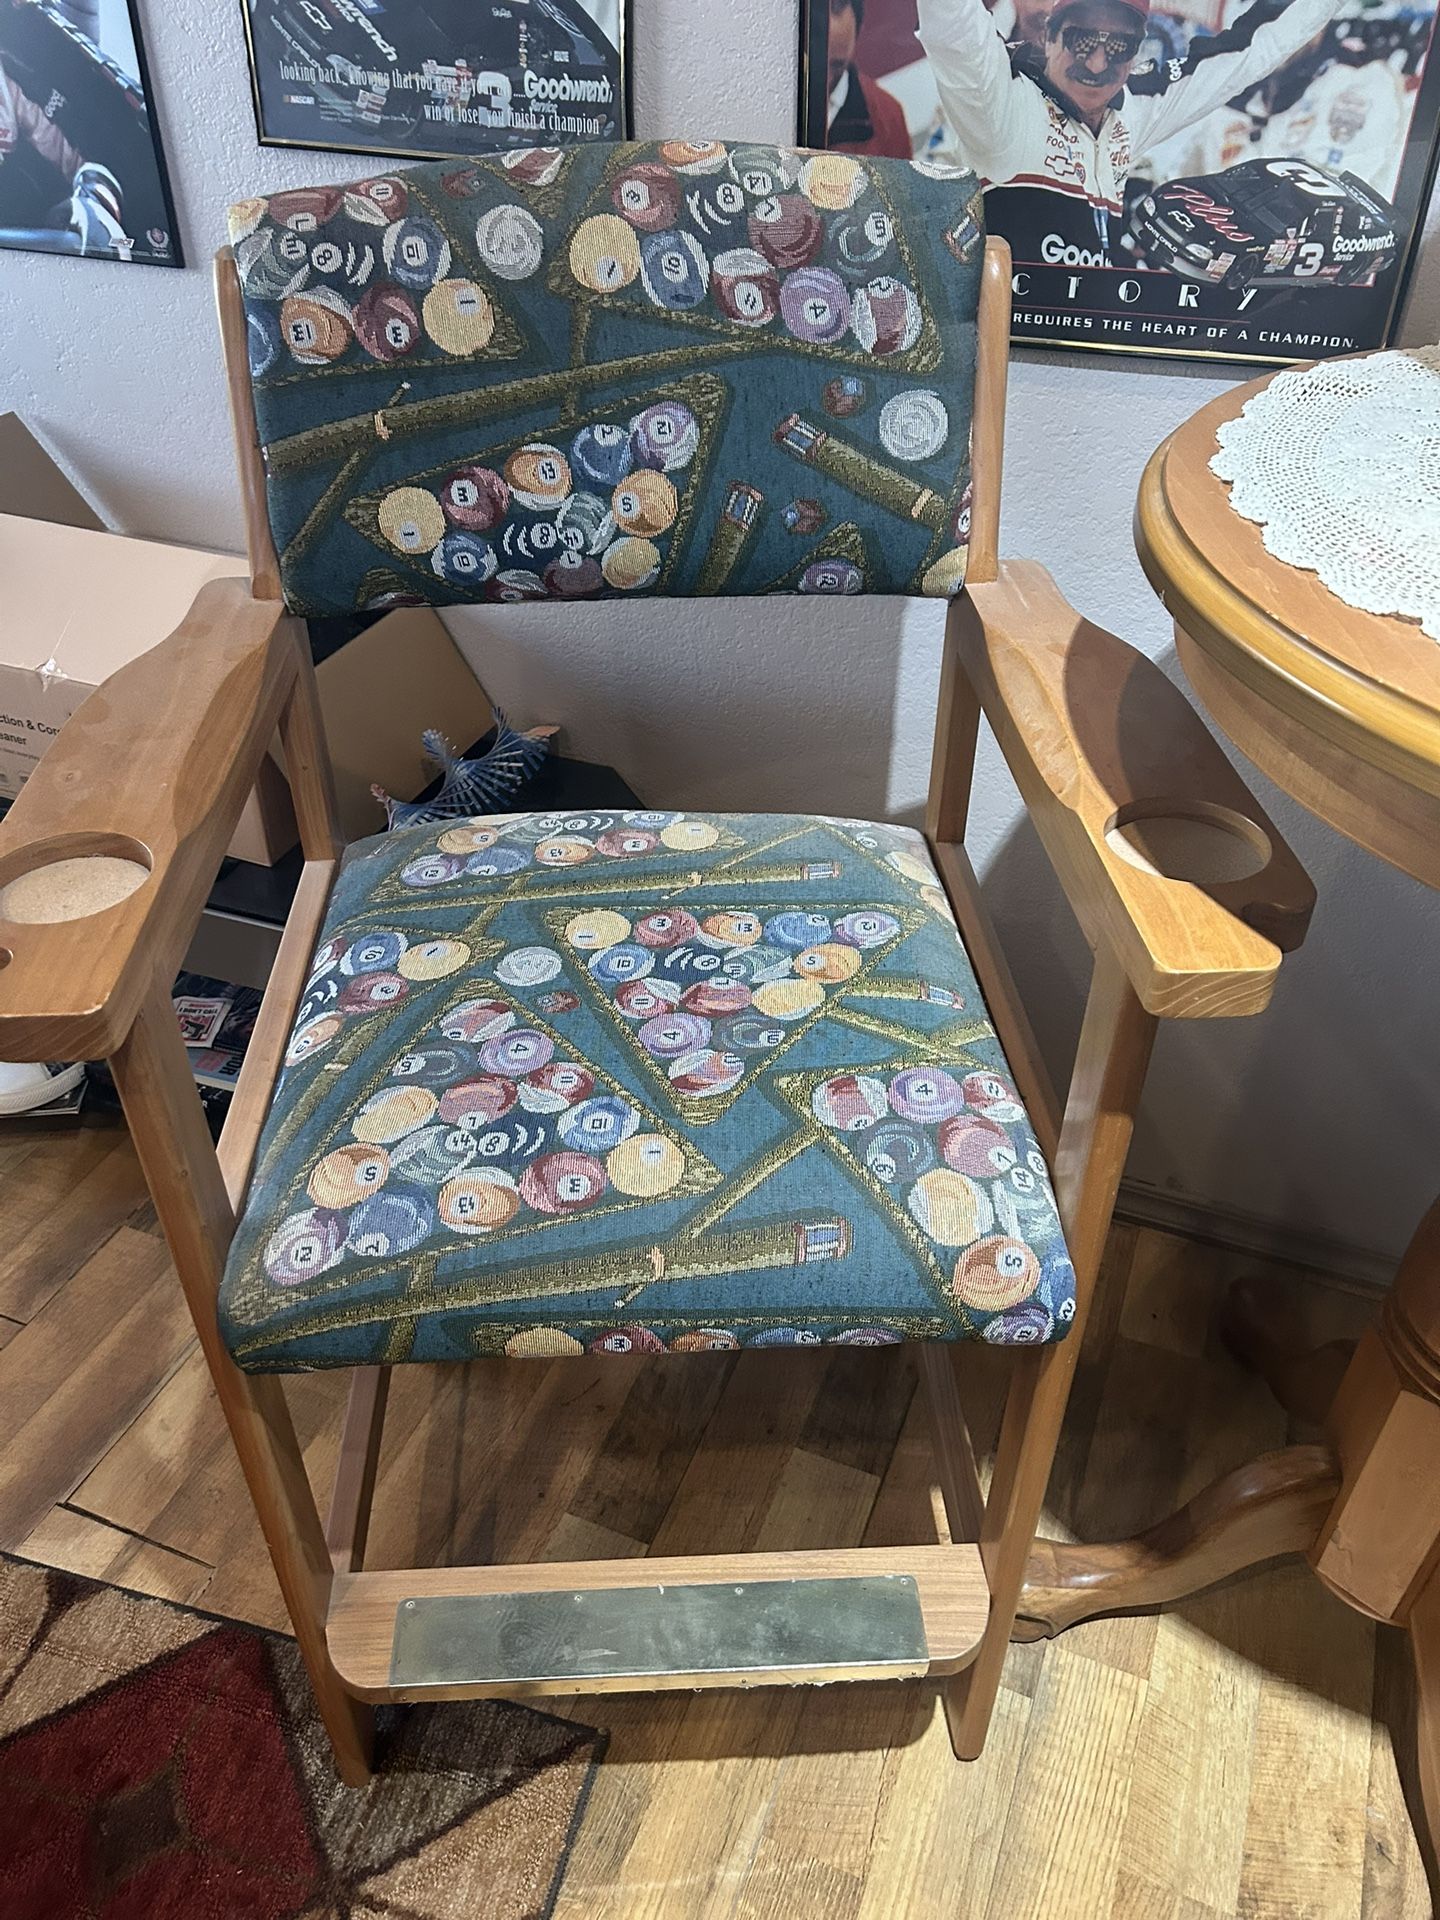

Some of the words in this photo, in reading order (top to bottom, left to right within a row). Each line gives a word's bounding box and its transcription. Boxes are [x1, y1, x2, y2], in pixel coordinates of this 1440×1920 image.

[279, 60, 316, 85] looking
[392, 69, 412, 89] that
[414, 72, 433, 93] you
[423, 101, 442, 121] win
[549, 112, 600, 136] champion
[1293, 242, 1325, 276] 3
[1013, 312, 1094, 329] REQUIRES
[1102, 318, 1134, 332] THE
[1141, 321, 1198, 338] HEART
[1206, 326, 1229, 341] OF
[1236, 328, 1249, 341] A
[1258, 331, 1360, 350] CHAMPION.
[27, 720, 36, 730] &
[37, 722, 62, 736] Cor
